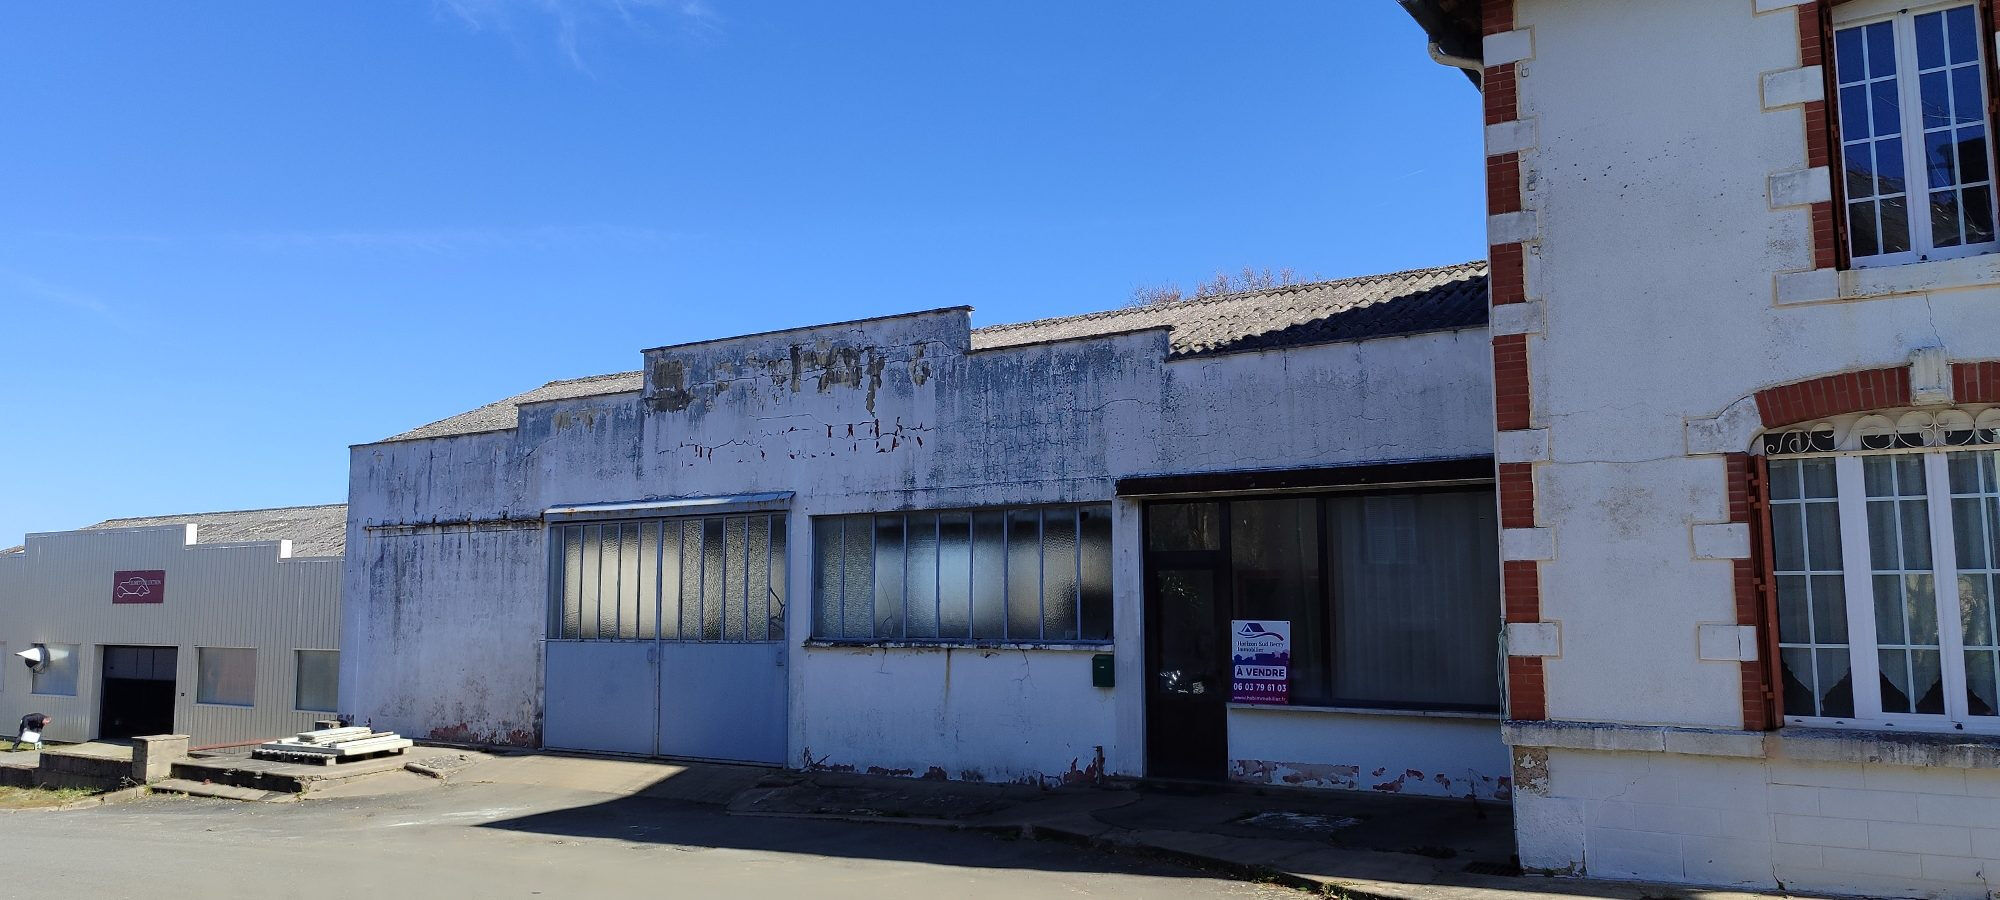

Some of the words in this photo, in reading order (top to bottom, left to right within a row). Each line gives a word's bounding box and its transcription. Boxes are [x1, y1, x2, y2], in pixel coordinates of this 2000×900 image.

[1236, 665, 1243, 676] À
[1246, 668, 1285, 677] VENDRE
[1245, 683, 1253, 691] 03
[1267, 684, 1275, 692] 61
[1277, 684, 1286, 692] 03
